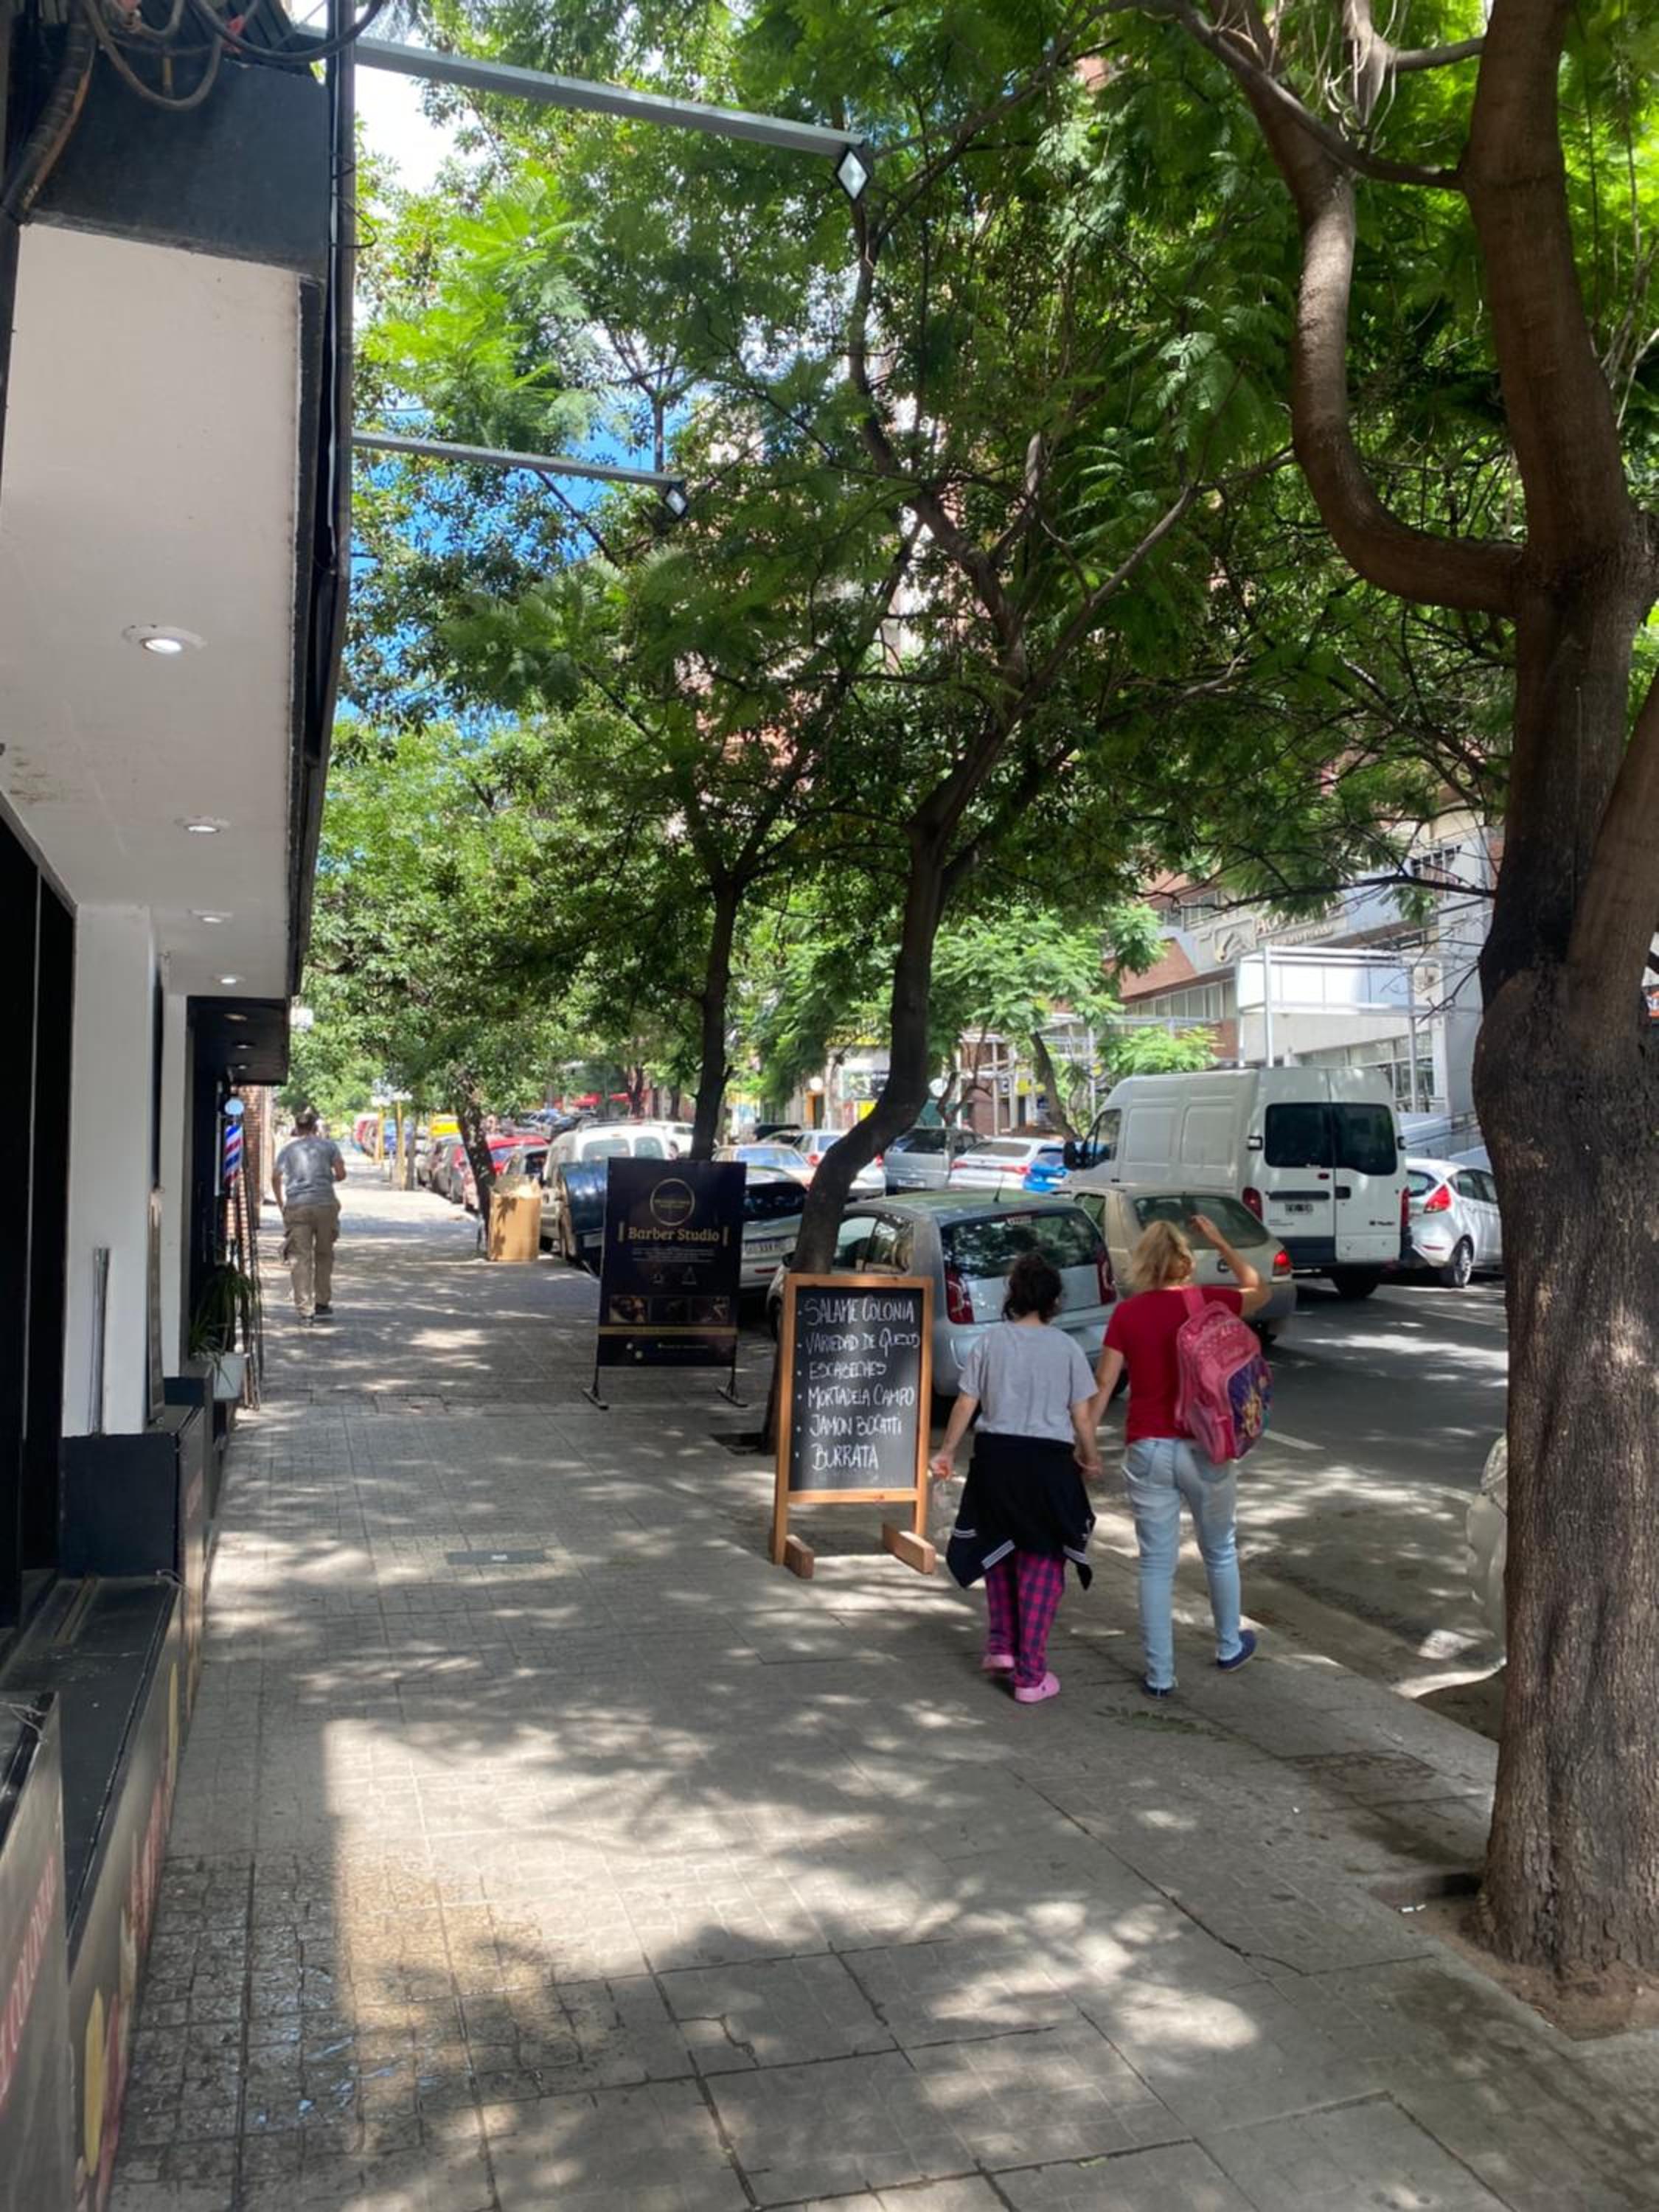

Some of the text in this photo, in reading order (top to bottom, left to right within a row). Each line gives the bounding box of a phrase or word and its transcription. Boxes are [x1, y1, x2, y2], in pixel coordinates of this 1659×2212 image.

[628, 1226, 720, 1242] Barber Studio
[804, 1295, 915, 1326] SALAME COLONIA
[805, 1333, 859, 1355] VARIEDAD
[861, 1332, 877, 1351] DE
[873, 1382, 915, 1407] CAMPO
[809, 1413, 852, 1438] JAMON
[811, 1442, 880, 1472] BURRATA
